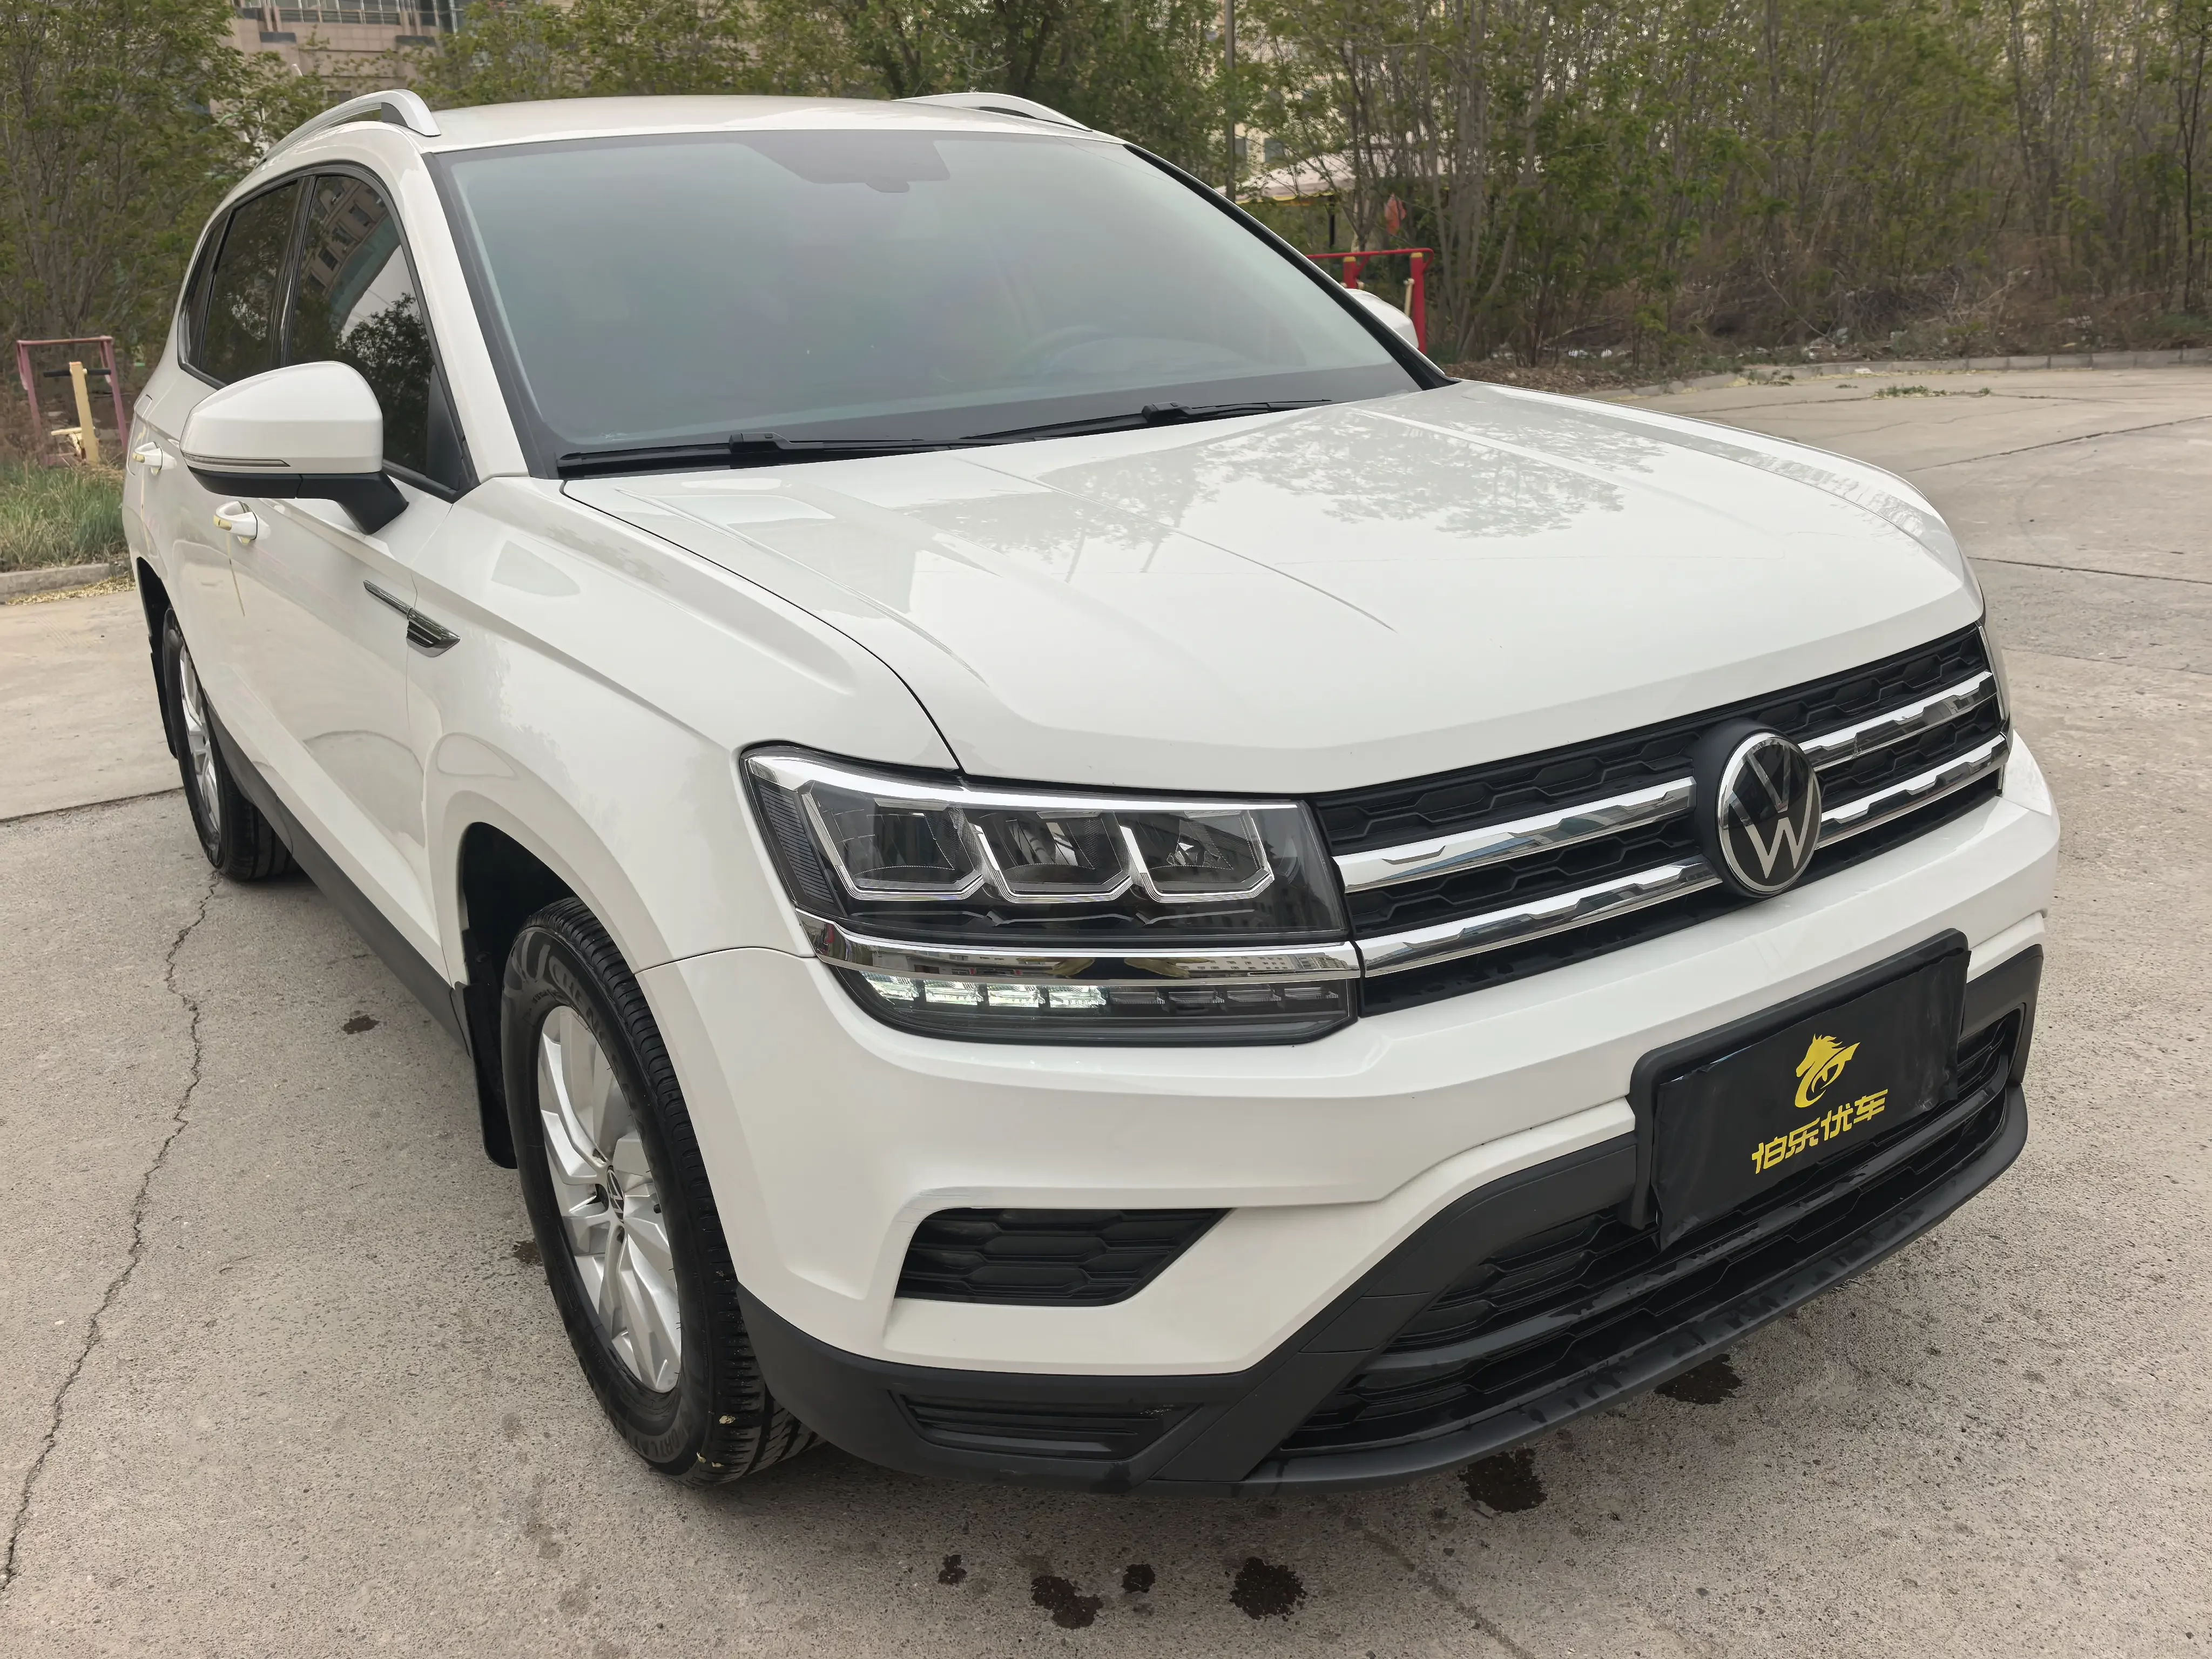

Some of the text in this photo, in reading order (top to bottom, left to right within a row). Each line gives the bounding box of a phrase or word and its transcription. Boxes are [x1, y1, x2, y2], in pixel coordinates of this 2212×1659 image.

[1729, 746, 1815, 879] VW
[1751, 1088, 1888, 1174] 伯乐优车
